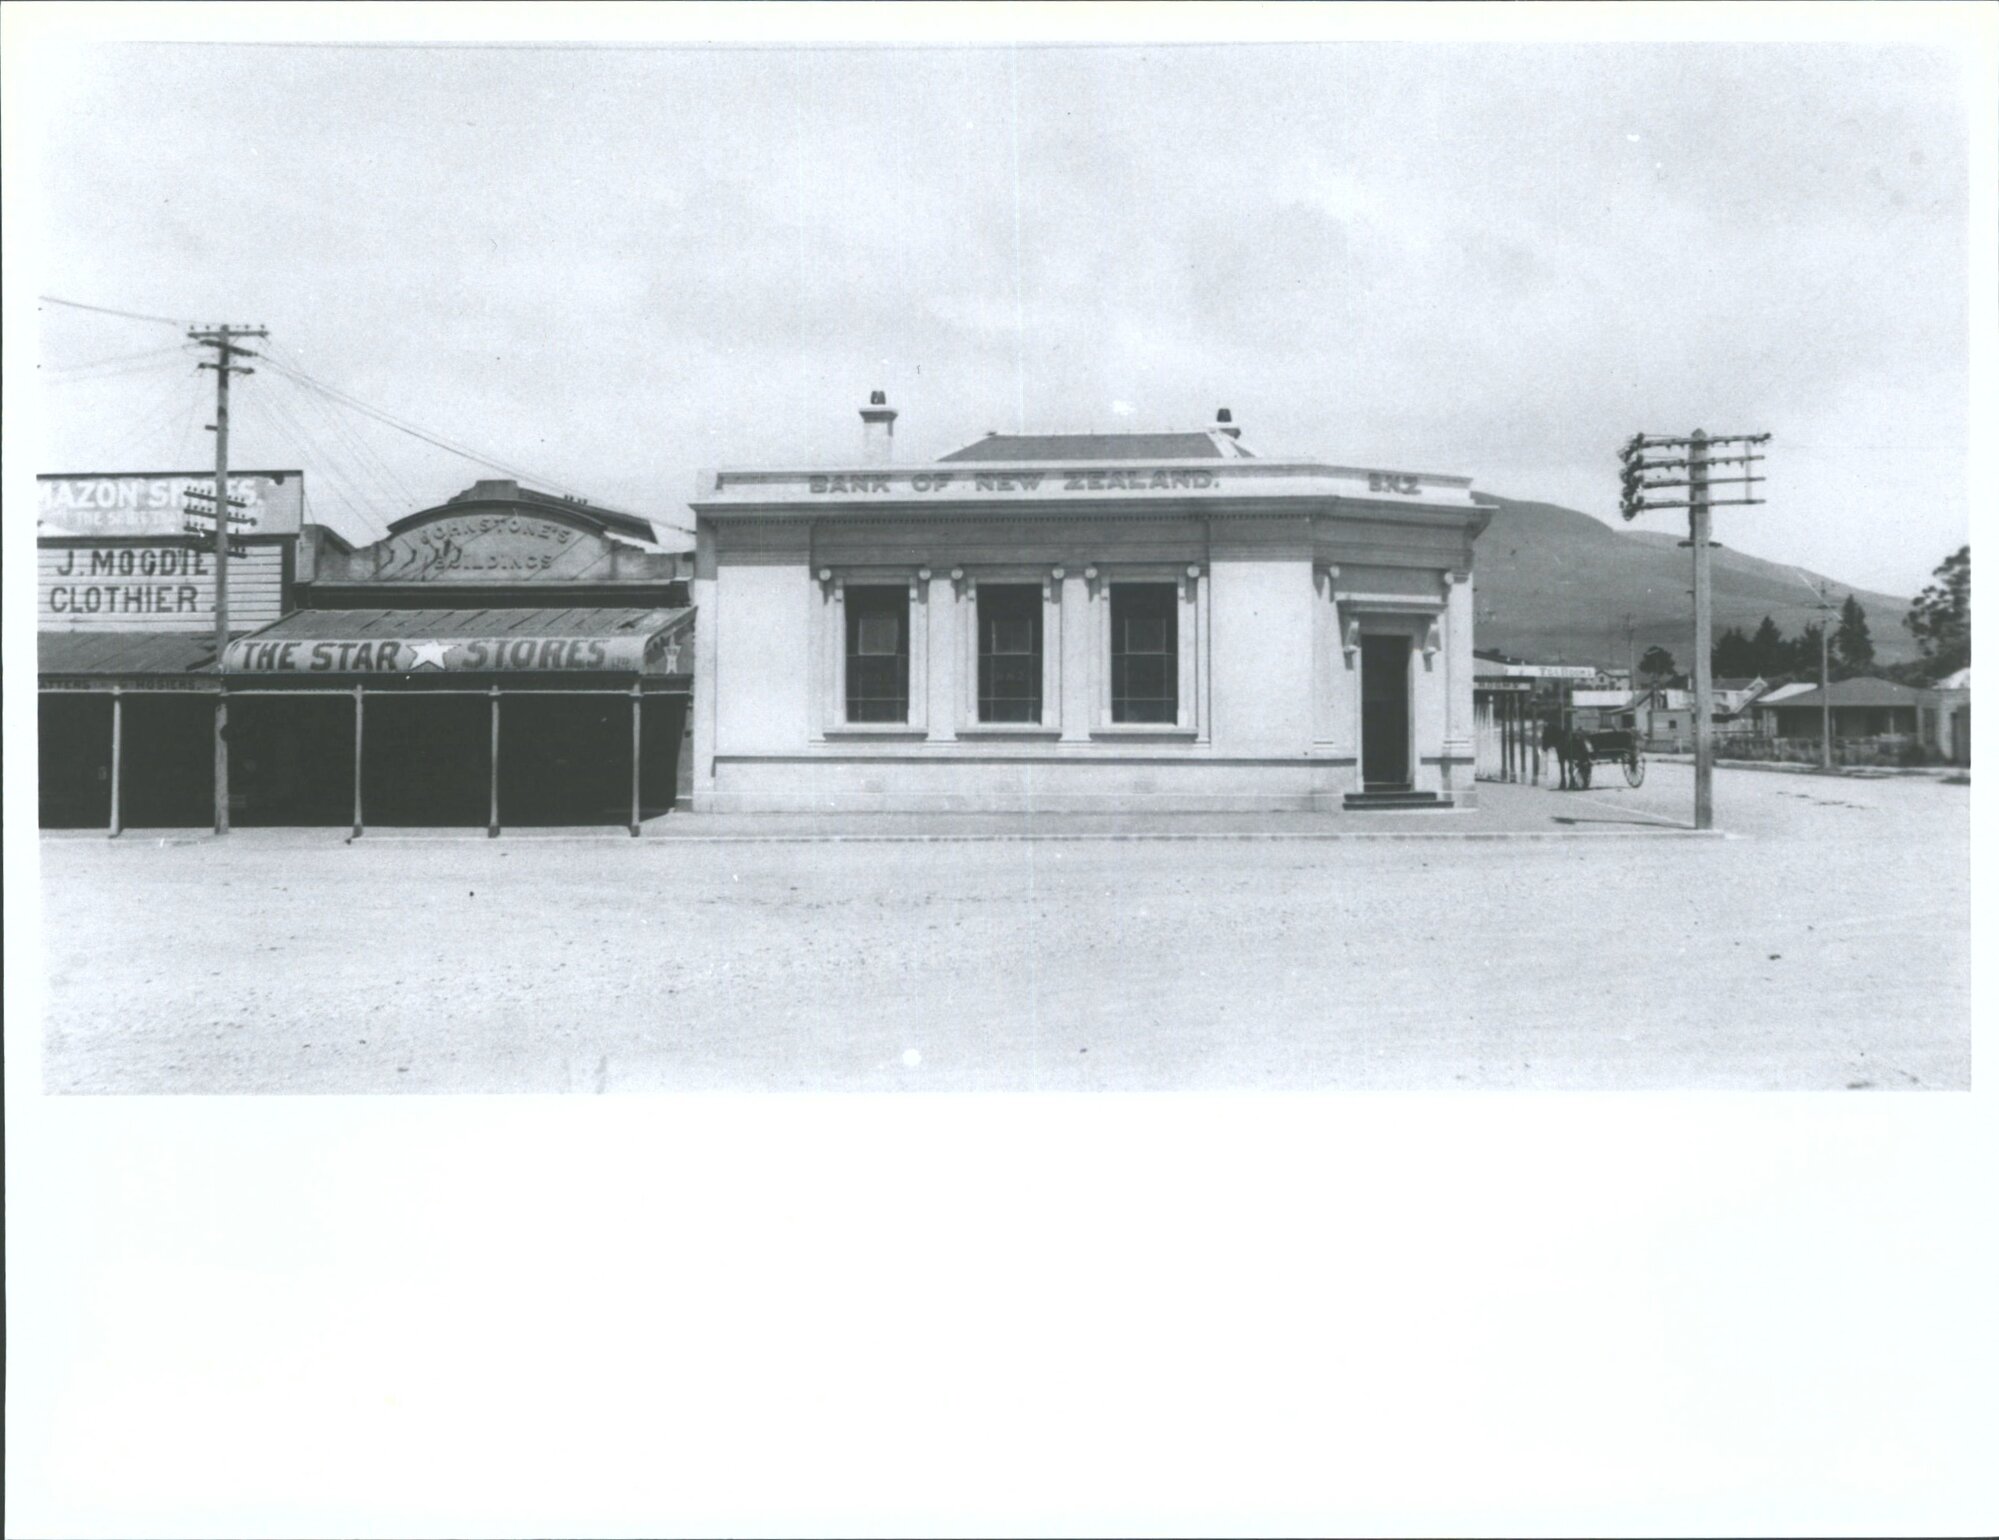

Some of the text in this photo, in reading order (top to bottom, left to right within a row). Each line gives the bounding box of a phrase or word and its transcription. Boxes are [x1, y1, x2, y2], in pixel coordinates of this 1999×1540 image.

[810, 469, 1220, 493] BANK OF NEW ZEALAND.
[1368, 472, 1422, 494] BNZ
[242, 641, 302, 671] THE
[310, 640, 401, 671] STAR
[461, 639, 611, 670] STORES
